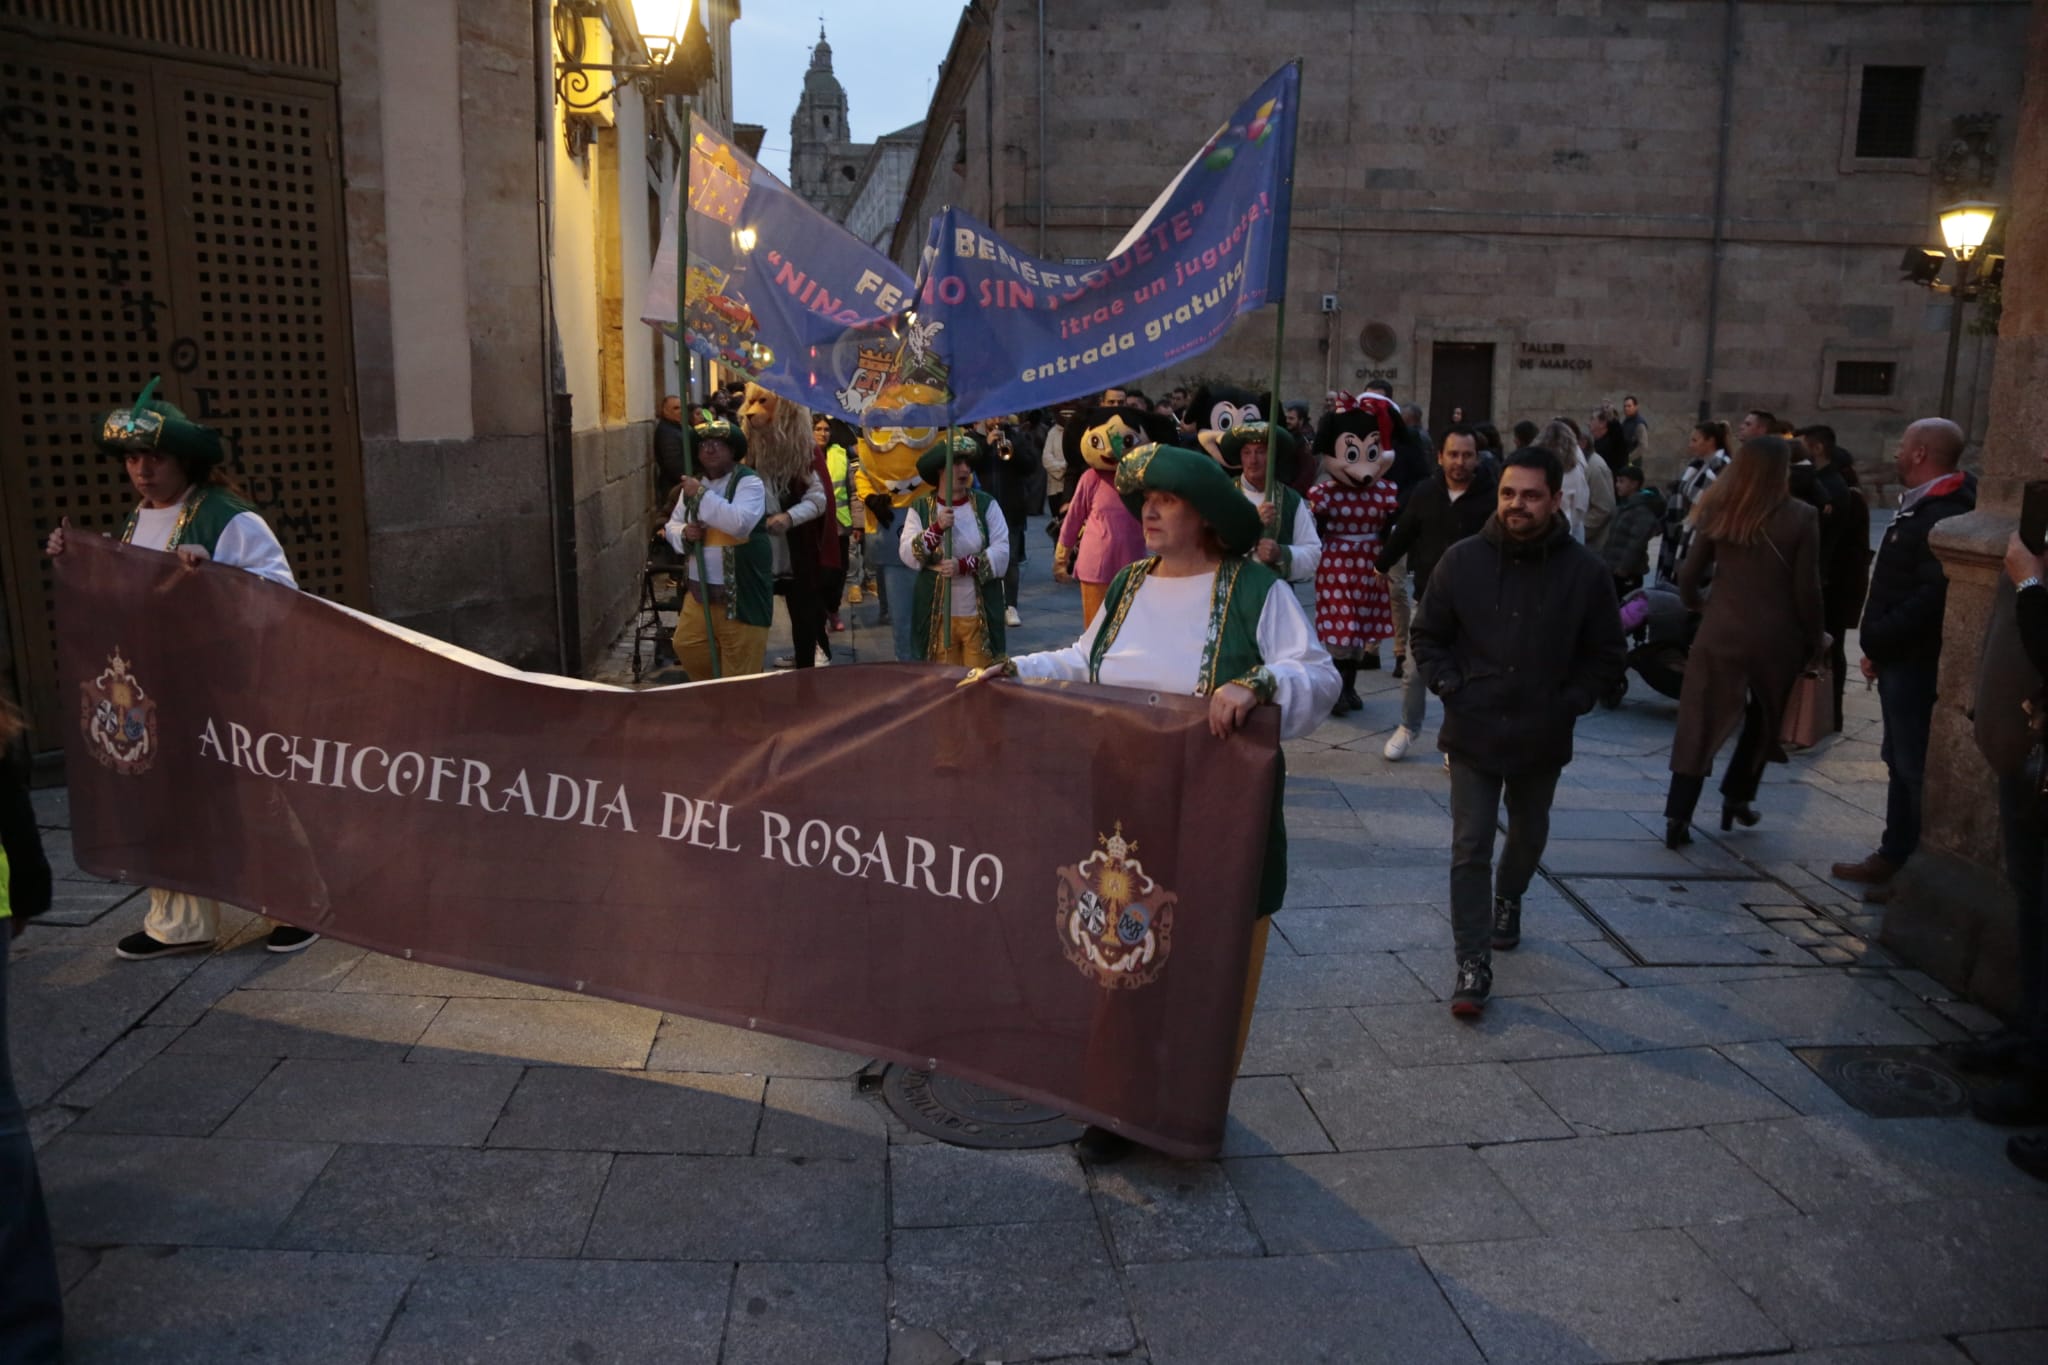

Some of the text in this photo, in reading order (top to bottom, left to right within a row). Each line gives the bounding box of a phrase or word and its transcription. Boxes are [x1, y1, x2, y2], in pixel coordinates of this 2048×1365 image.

[1134, 277, 1168, 305] un
[1176, 191, 1273, 287] juguete!
[979, 278, 1035, 310] SIN
[1021, 330, 1135, 383] entrada
[1144, 258, 1246, 342] gratuita
[1520, 358, 1593, 369] DE MARCOS
[1521, 342, 1566, 354] TALLER
[198, 716, 1004, 905] ARCHICOFRADIA DEL ROSARIO
